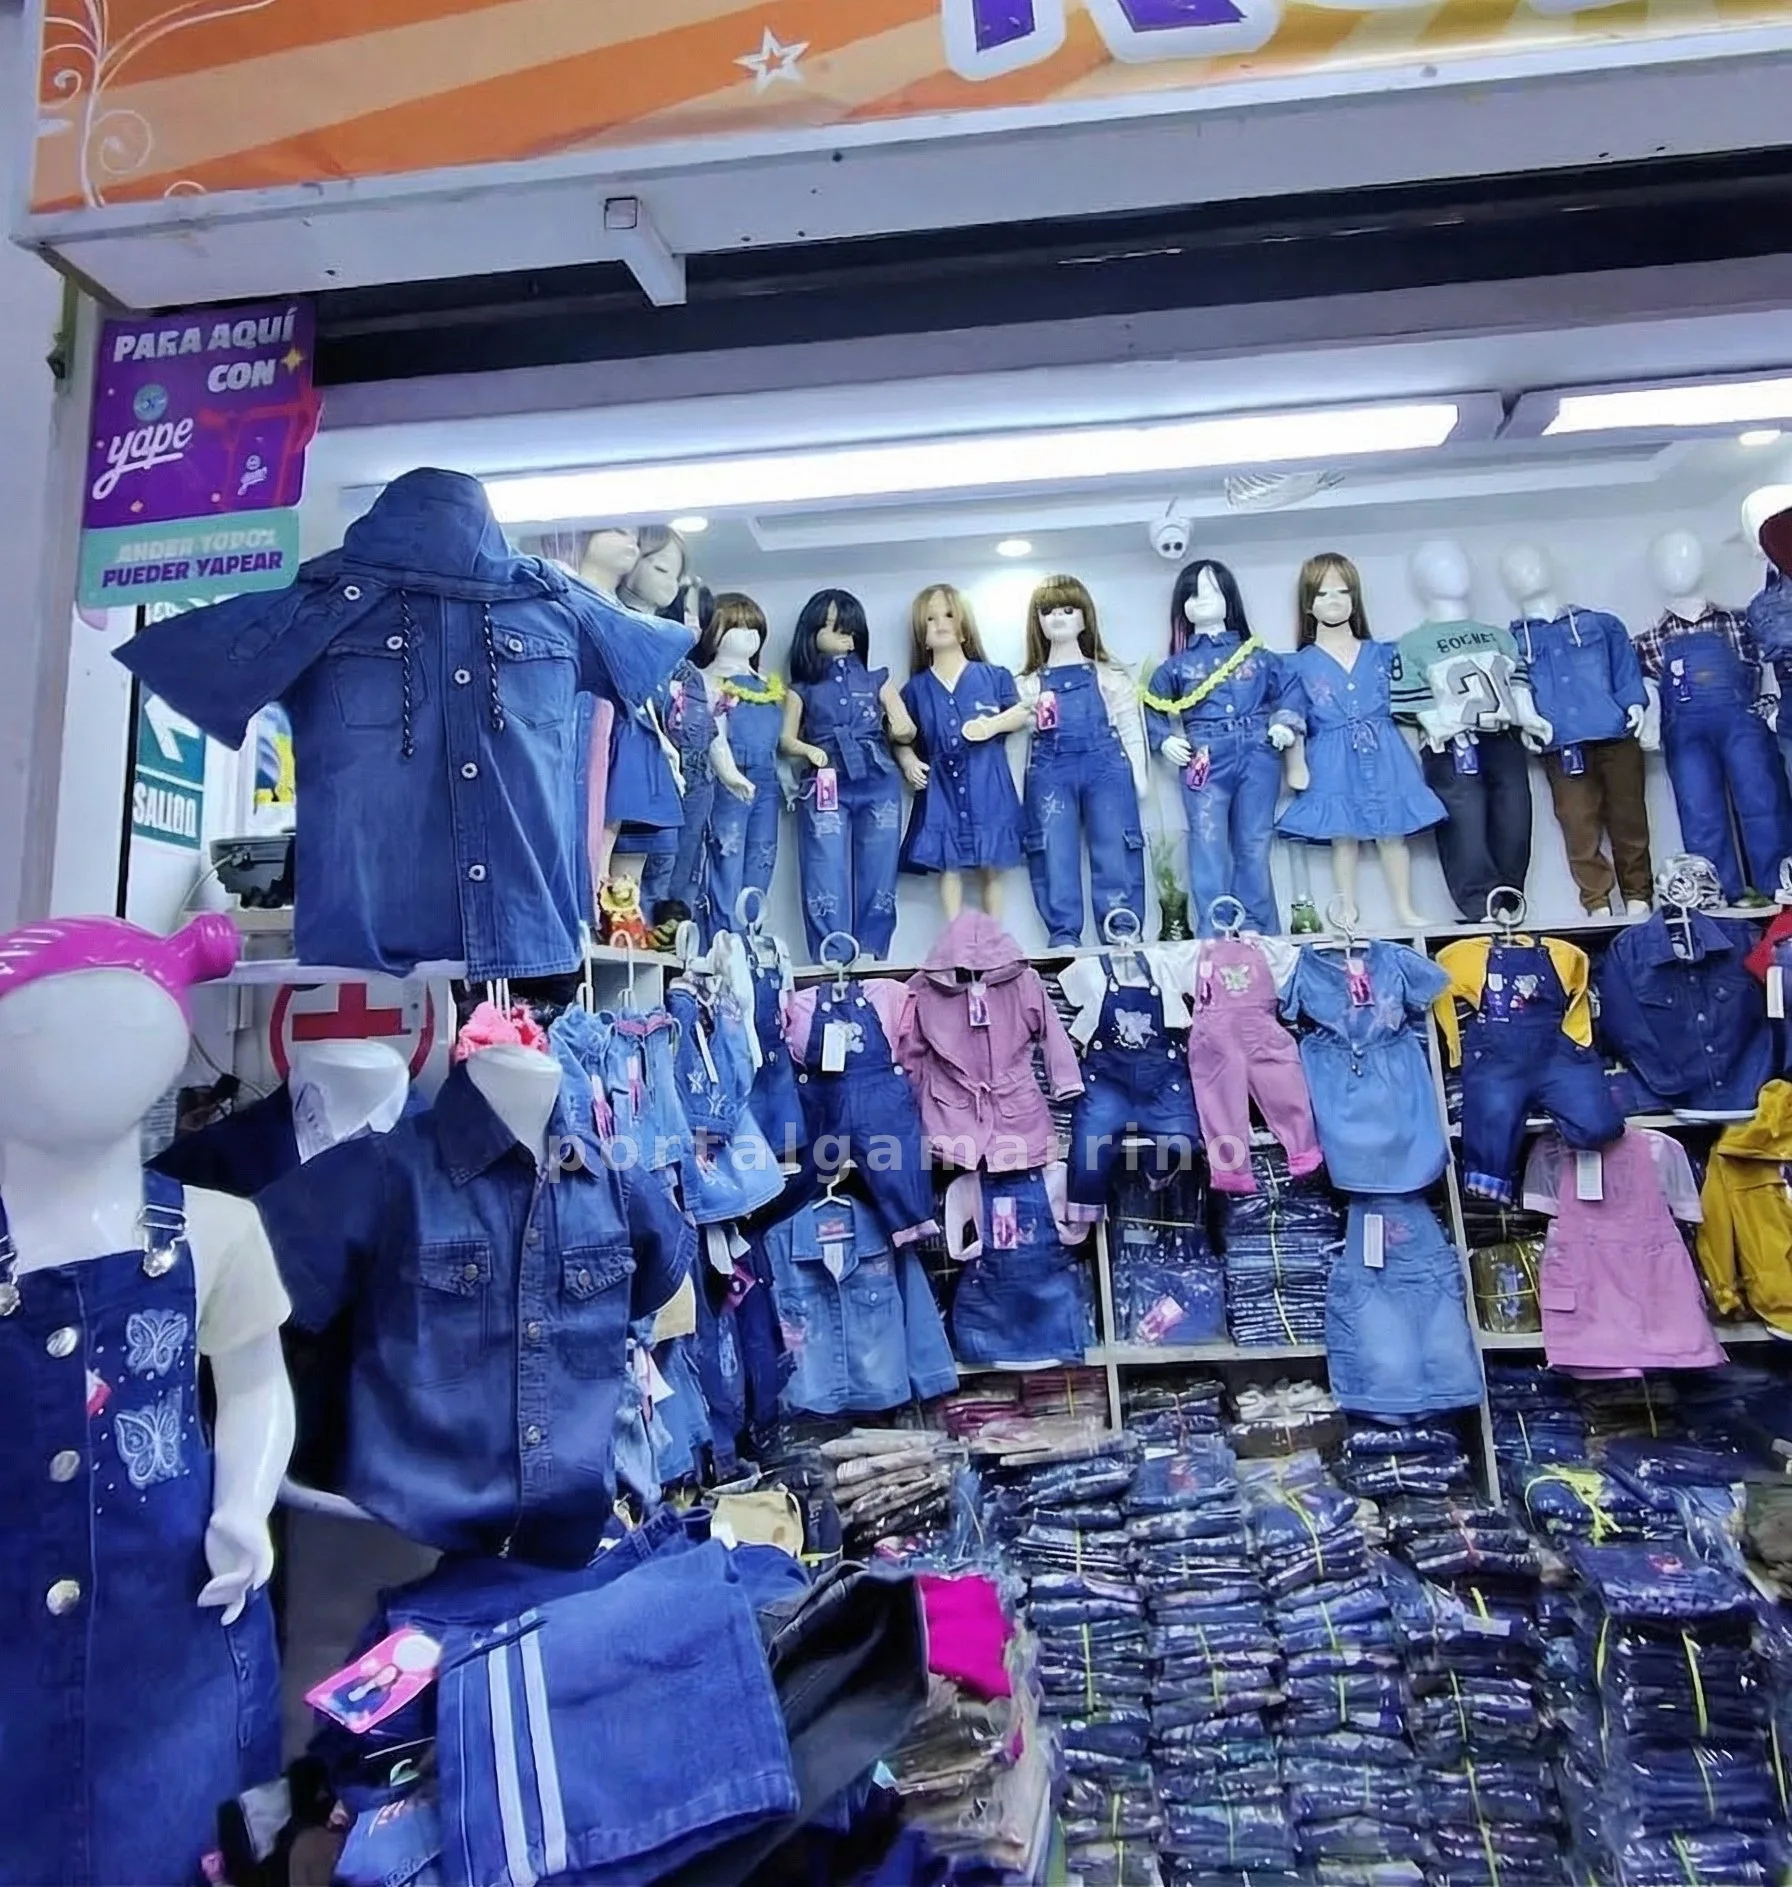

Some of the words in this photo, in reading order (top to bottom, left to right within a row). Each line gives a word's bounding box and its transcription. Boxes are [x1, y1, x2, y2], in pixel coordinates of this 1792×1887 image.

[207, 307, 298, 350] AQUÍ
[208, 359, 276, 393] CON
[92, 418, 194, 499] yape
[196, 551, 283, 577] YAPEAR
